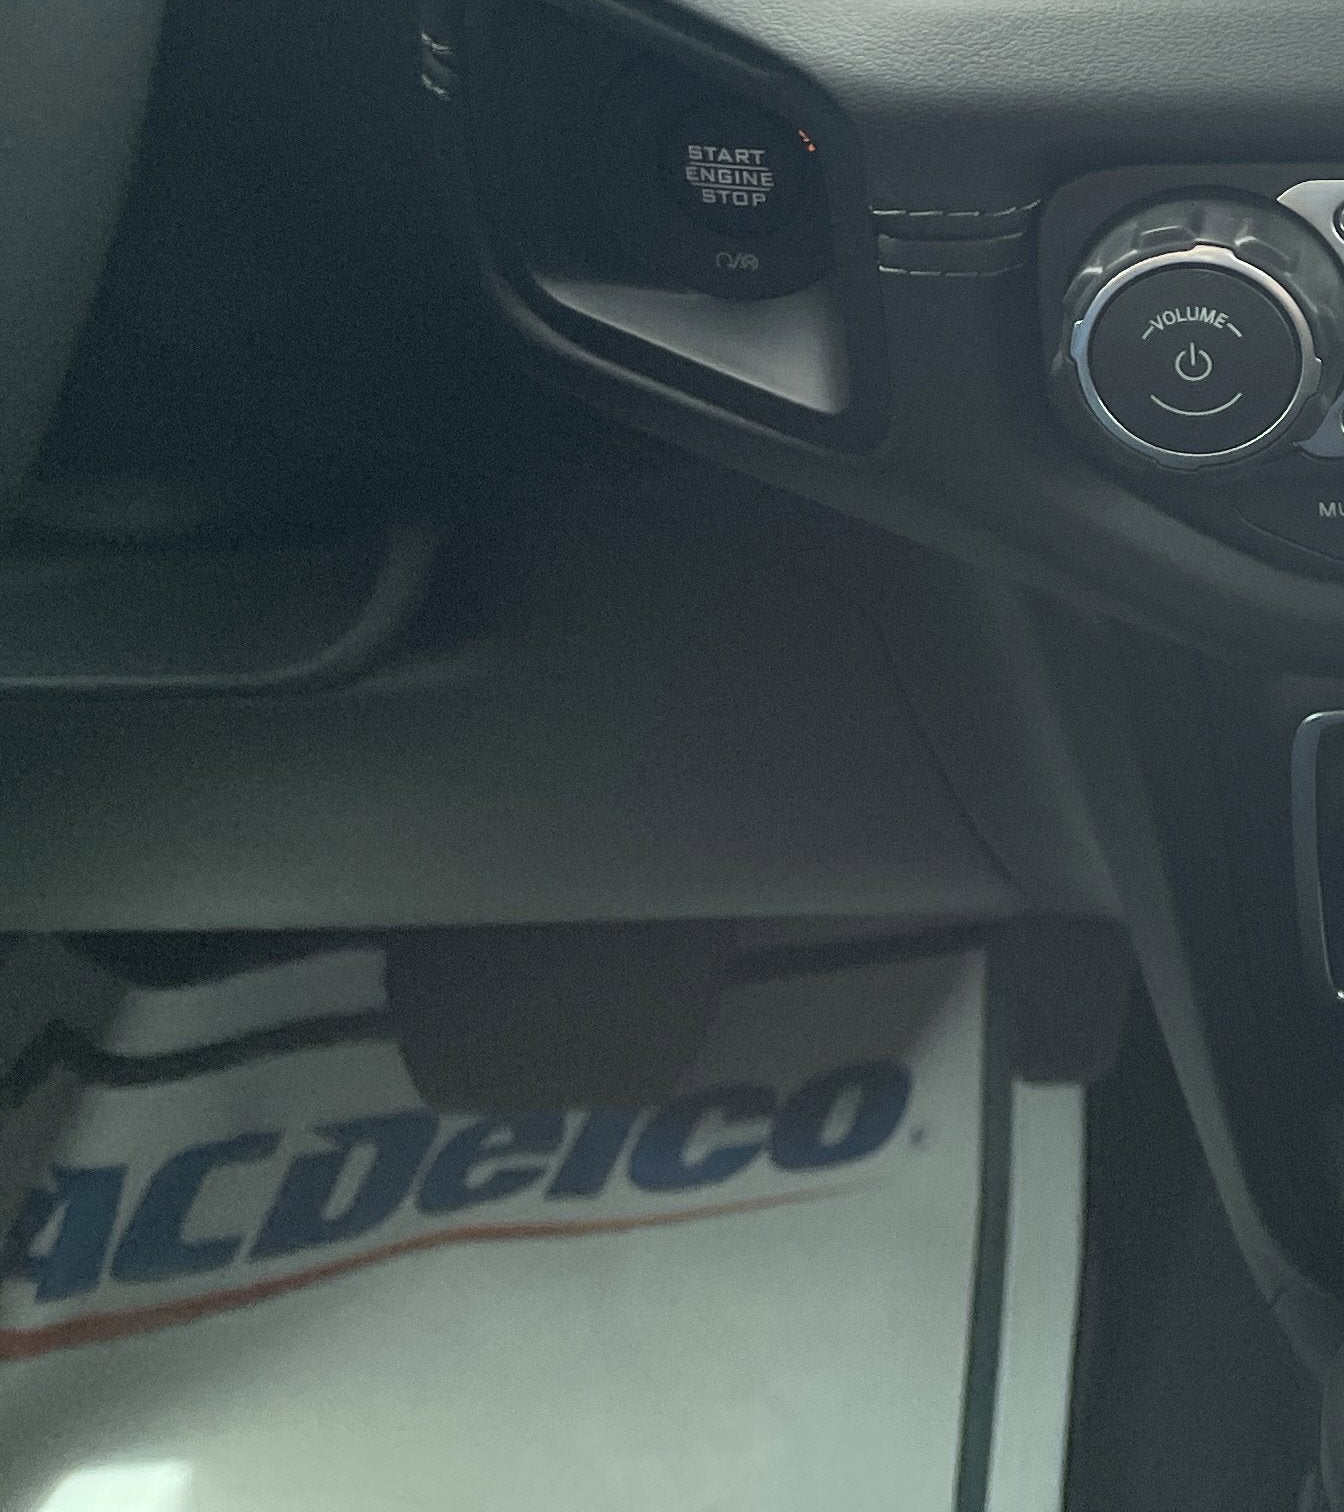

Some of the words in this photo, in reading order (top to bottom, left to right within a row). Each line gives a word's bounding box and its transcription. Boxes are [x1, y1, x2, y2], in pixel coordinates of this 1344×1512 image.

[688, 145, 766, 165] START
[686, 166, 775, 187] ENGINE
[702, 188, 766, 207] STOP
[1150, 306, 1229, 331] VOLUME
